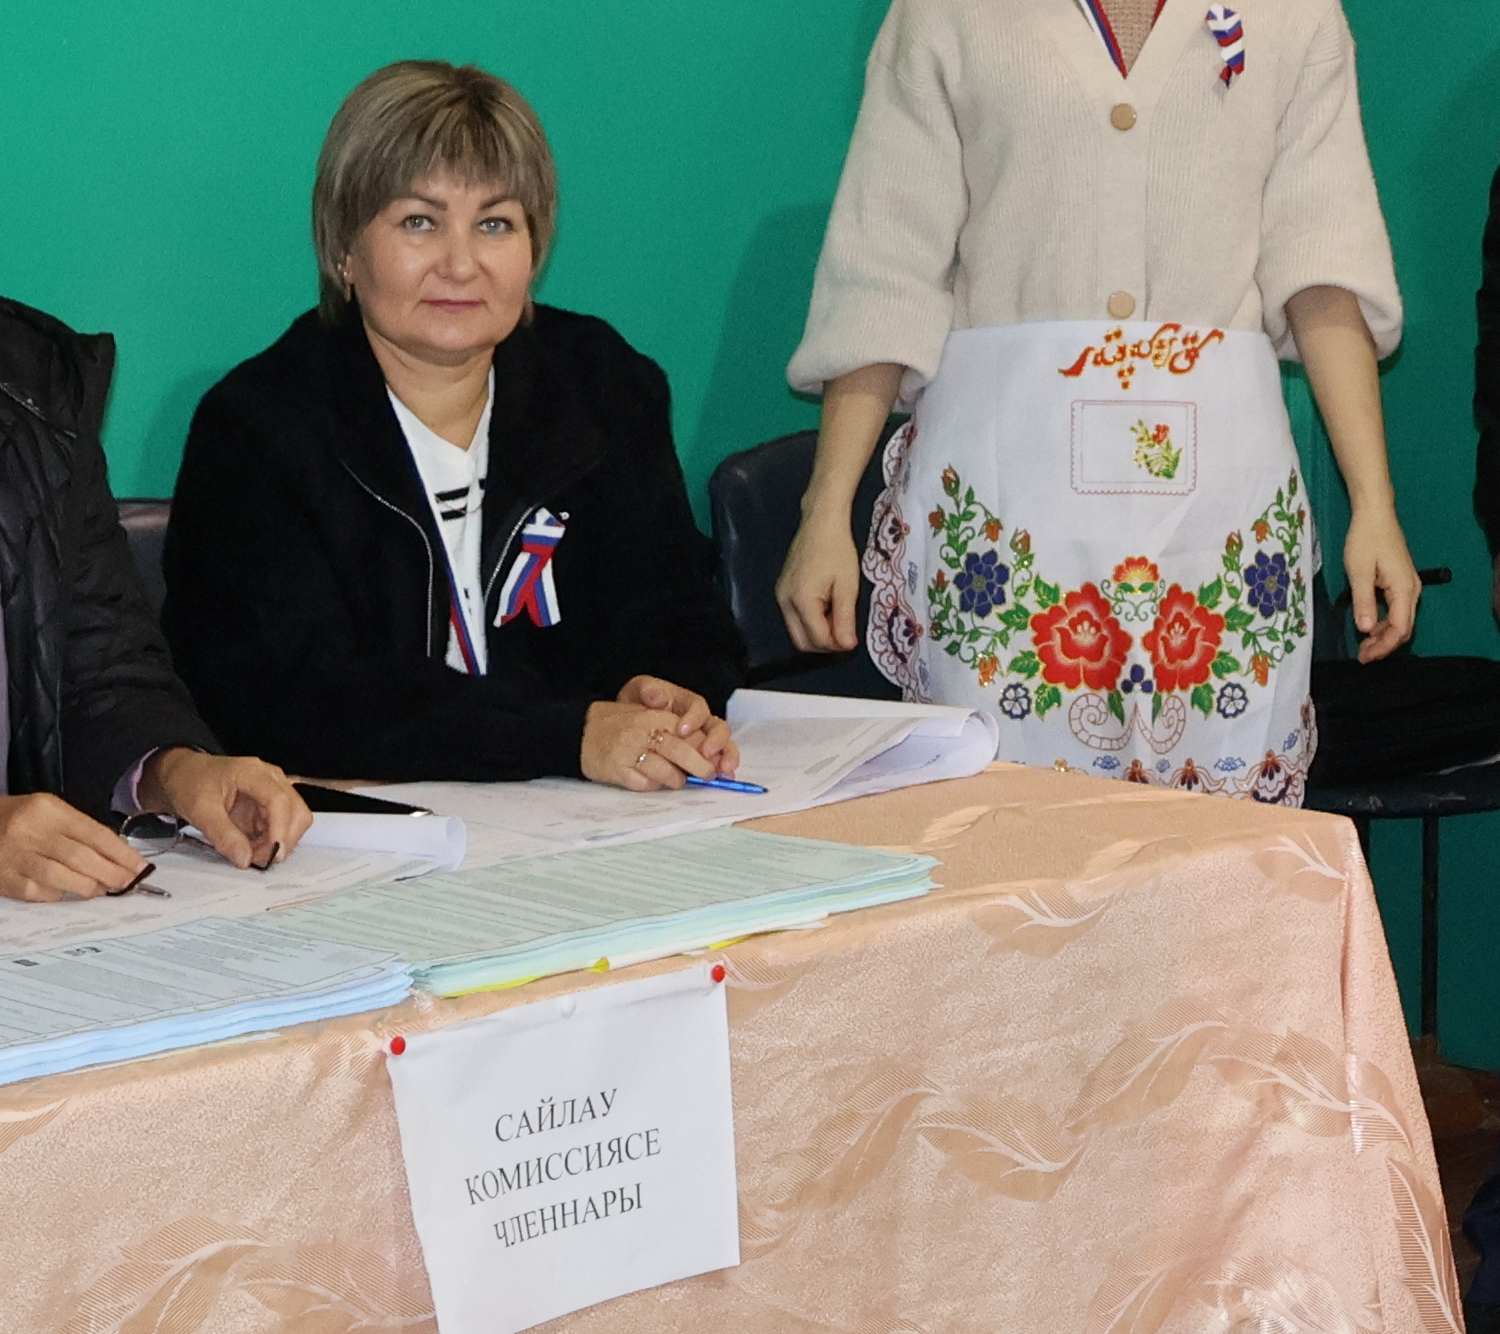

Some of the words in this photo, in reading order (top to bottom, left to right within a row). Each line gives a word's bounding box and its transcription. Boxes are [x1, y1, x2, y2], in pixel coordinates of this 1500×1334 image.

[494, 1088, 618, 1143] САЙЛАУ
[464, 1127, 662, 1206] КОМИССИЯСЕ
[492, 1182, 643, 1249] ЧЛЕННАРЫ
